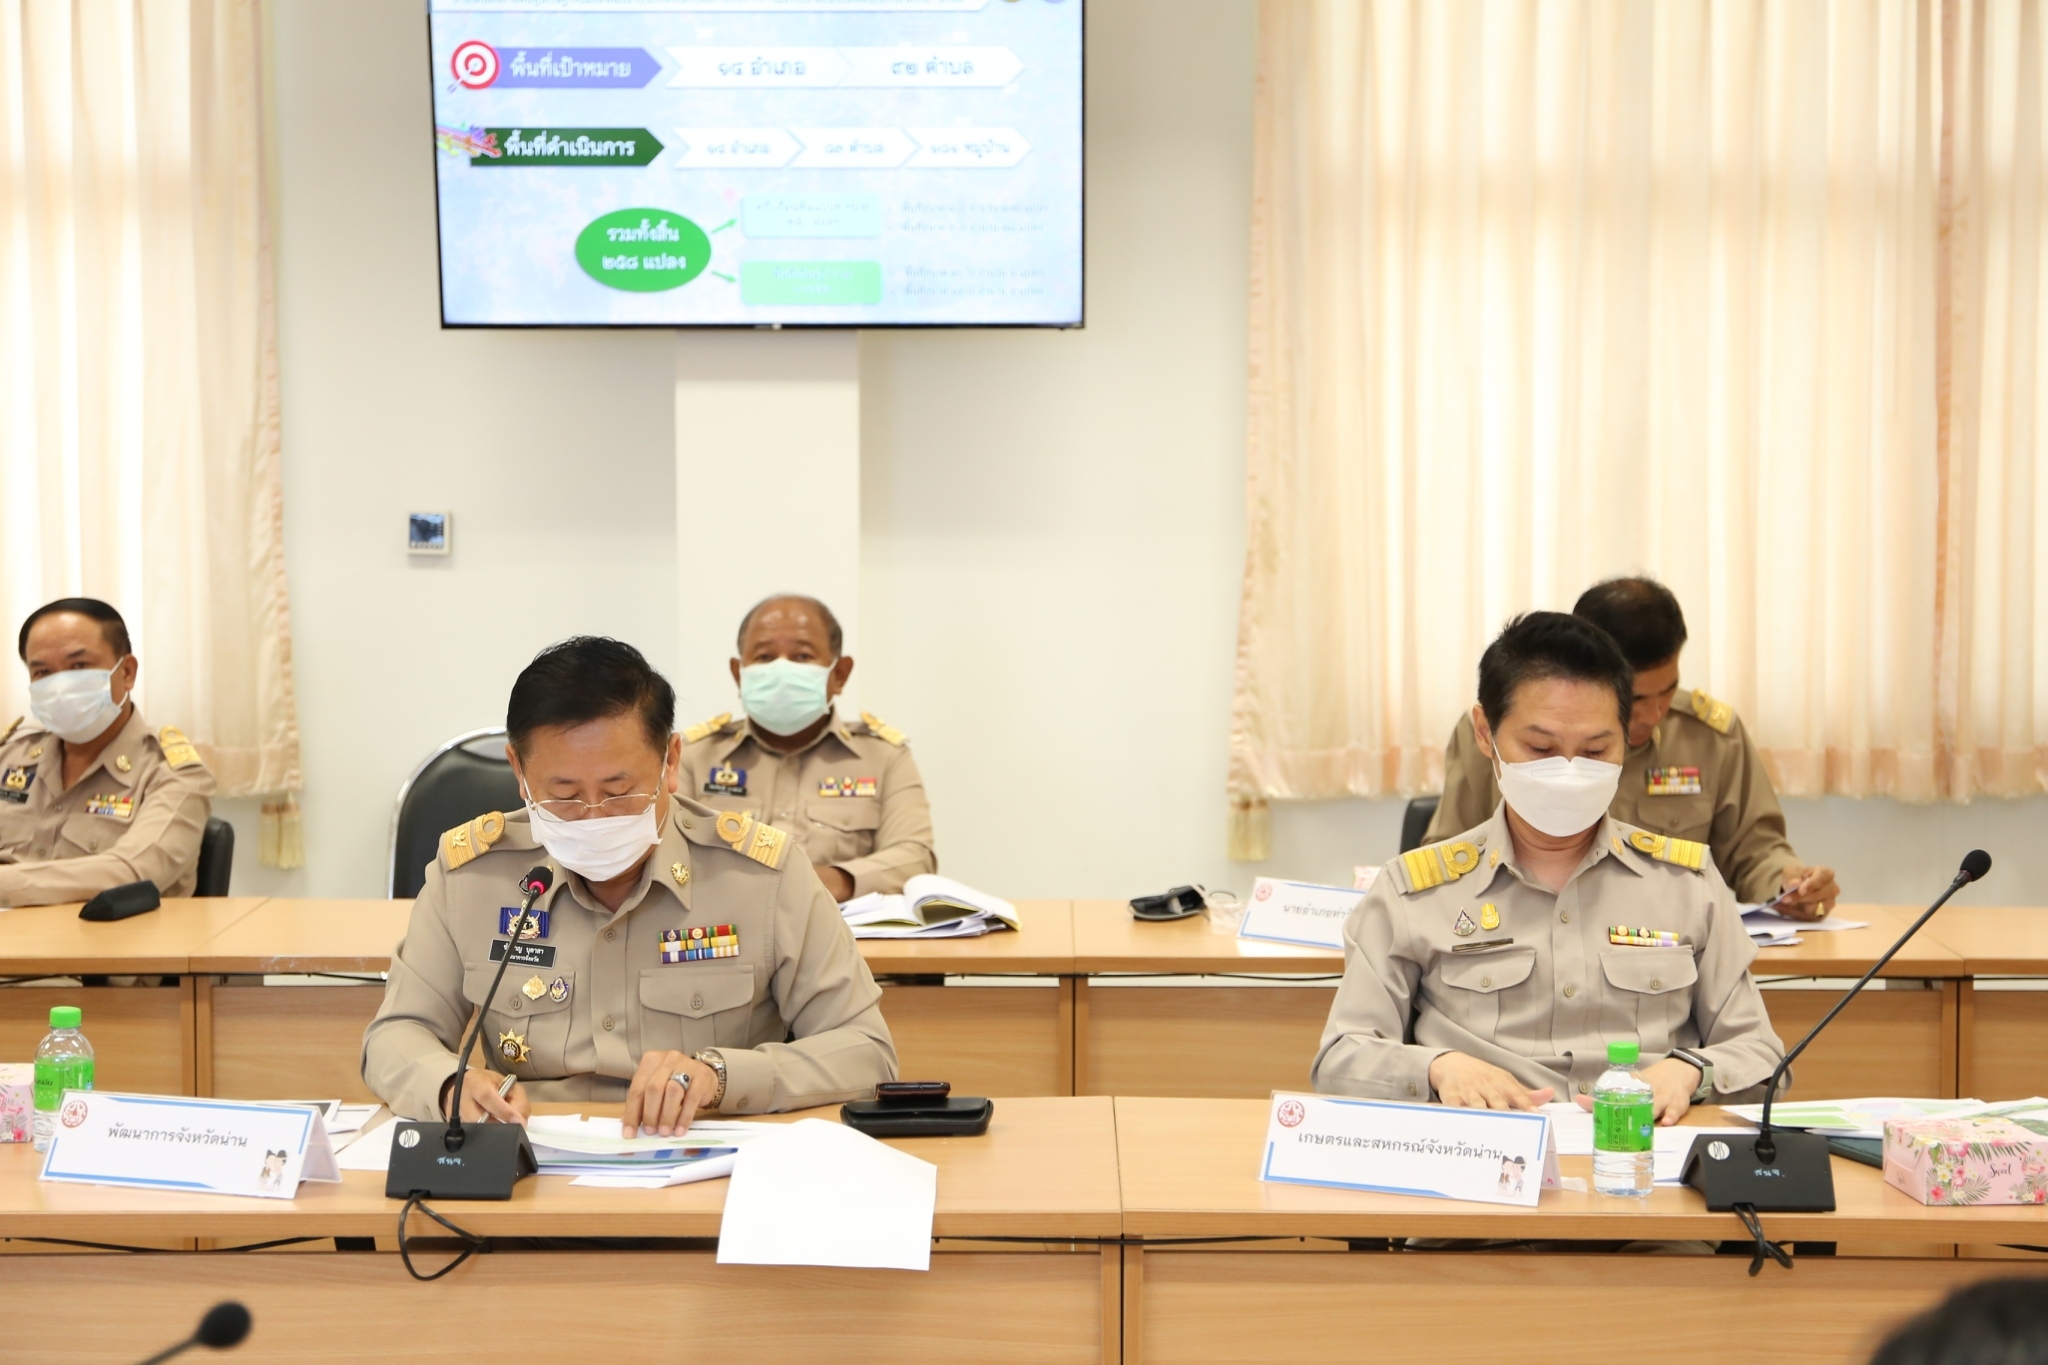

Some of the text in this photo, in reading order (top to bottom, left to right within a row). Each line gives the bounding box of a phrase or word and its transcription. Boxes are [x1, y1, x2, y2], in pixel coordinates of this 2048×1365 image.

[509, 50, 632, 78] พื้นที่เป้าหมาย
[750, 56, 806, 76] อำเภอ
[504, 129, 636, 157] พื้นที่ดำเนินการ
[108, 1122, 248, 1147] พัฒนาการจังหวัดน่าน
[1298, 1132, 1503, 1160] เกษตรและสหกรณ์จังหวัดน่าน
